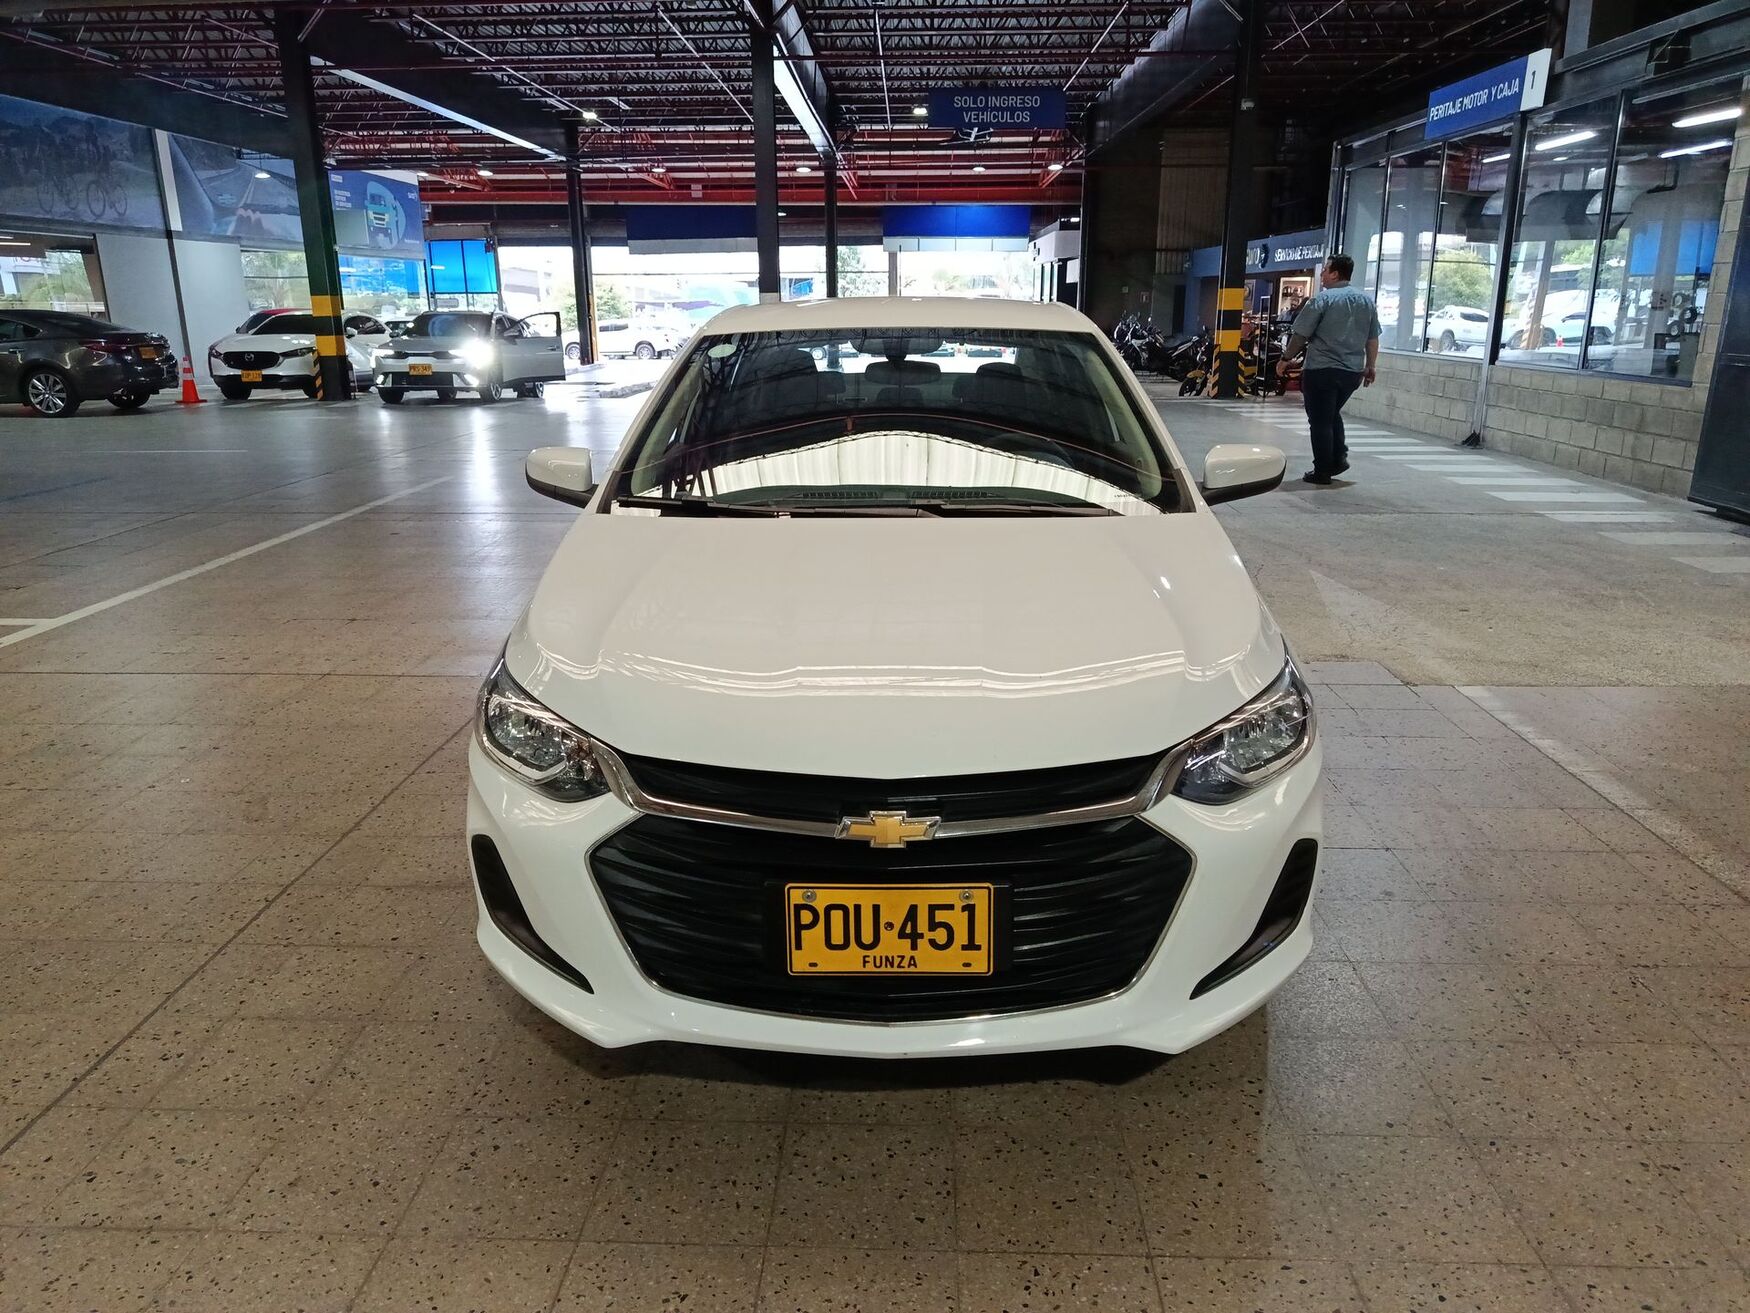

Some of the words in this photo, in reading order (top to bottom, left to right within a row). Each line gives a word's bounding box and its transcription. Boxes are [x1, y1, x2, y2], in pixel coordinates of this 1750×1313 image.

[1530, 70, 1537, 90] 1
[953, 96, 986, 108] SOLO
[988, 95, 1041, 108] INGRESO
[1429, 98, 1462, 121] PERITAJE
[1462, 89, 1488, 112] MOTOR
[1491, 86, 1498, 102] Y
[1497, 77, 1519, 99] CAJA
[963, 108, 1031, 123] VEHÍCULOS
[862, 954, 918, 969] FUNZA
